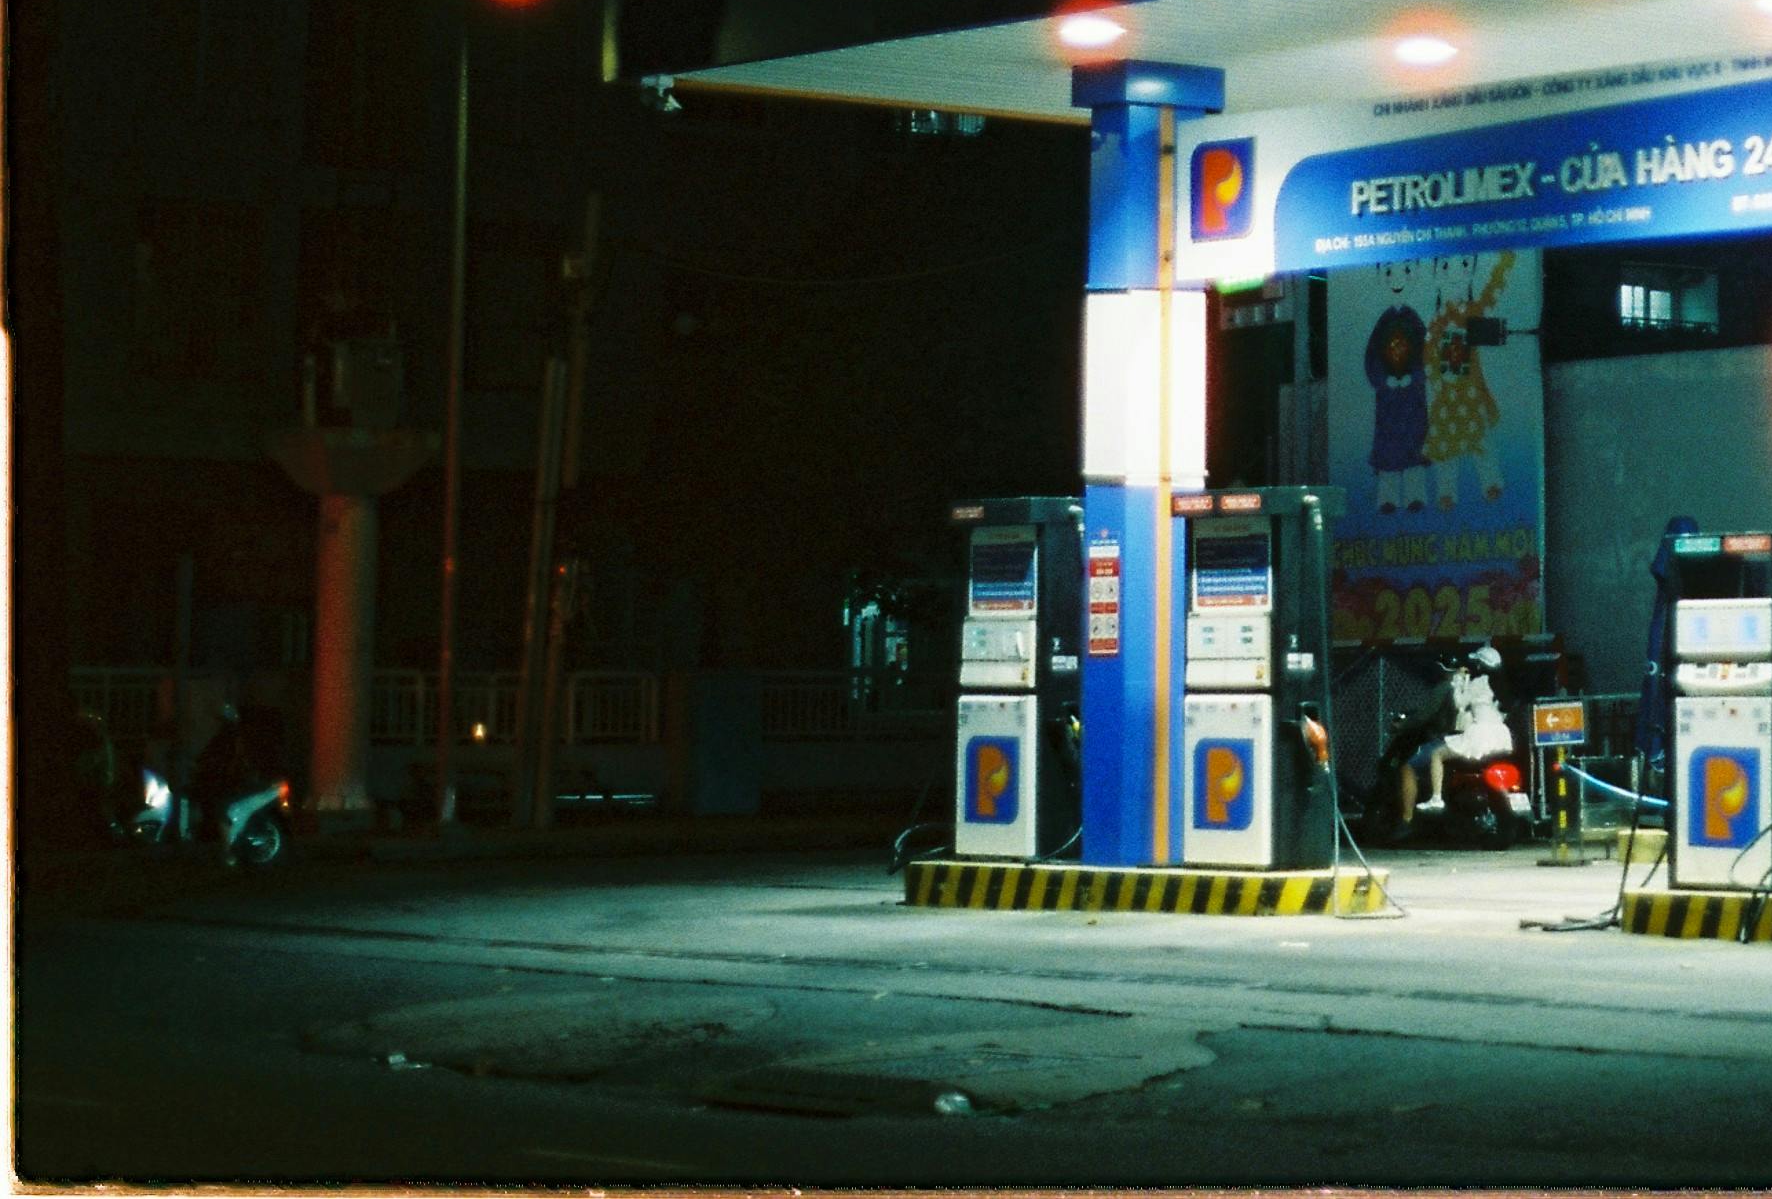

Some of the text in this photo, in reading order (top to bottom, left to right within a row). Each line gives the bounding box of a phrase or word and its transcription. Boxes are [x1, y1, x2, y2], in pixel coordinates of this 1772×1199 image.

[1351, 161, 1537, 217] PETROLIMEX
[1635, 133, 1735, 186] HÀNG
[1376, 585, 1492, 639] 2025
